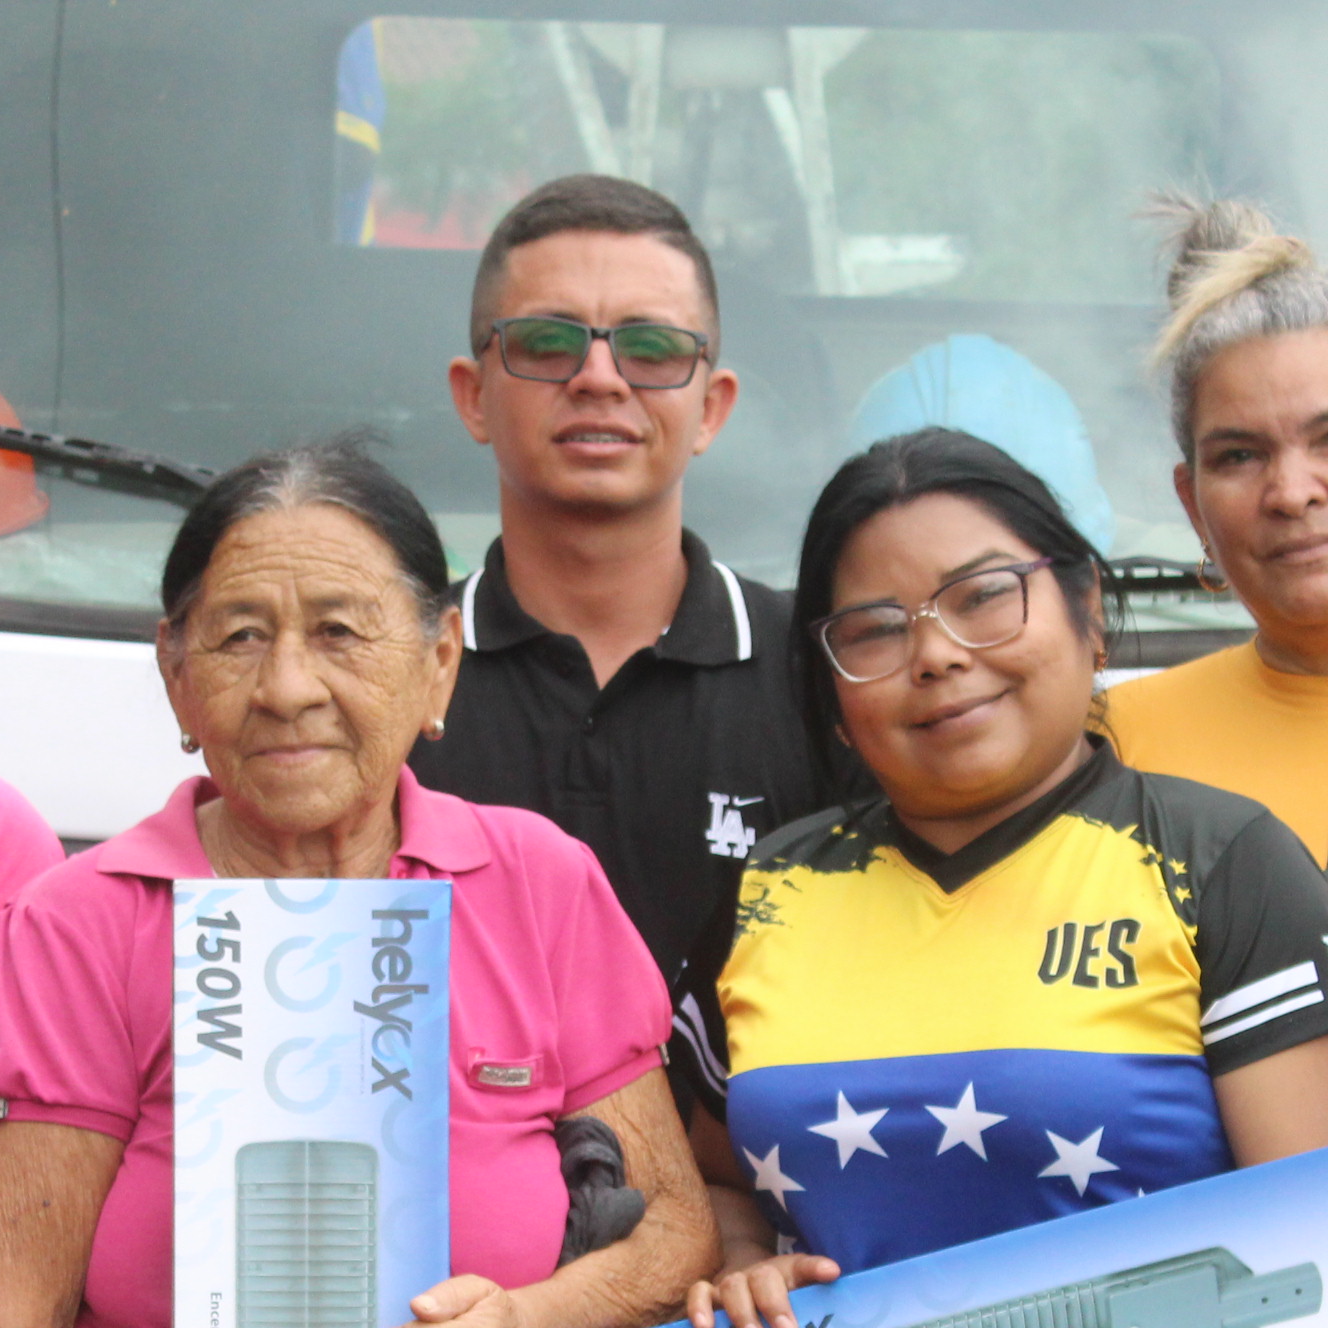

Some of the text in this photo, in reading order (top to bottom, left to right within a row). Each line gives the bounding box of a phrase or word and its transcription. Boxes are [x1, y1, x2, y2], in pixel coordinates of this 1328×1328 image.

[705, 792, 755, 859] LA
[196, 909, 243, 1061] 150W
[353, 908, 429, 1101] helyox
[1038, 917, 1142, 990] UES
